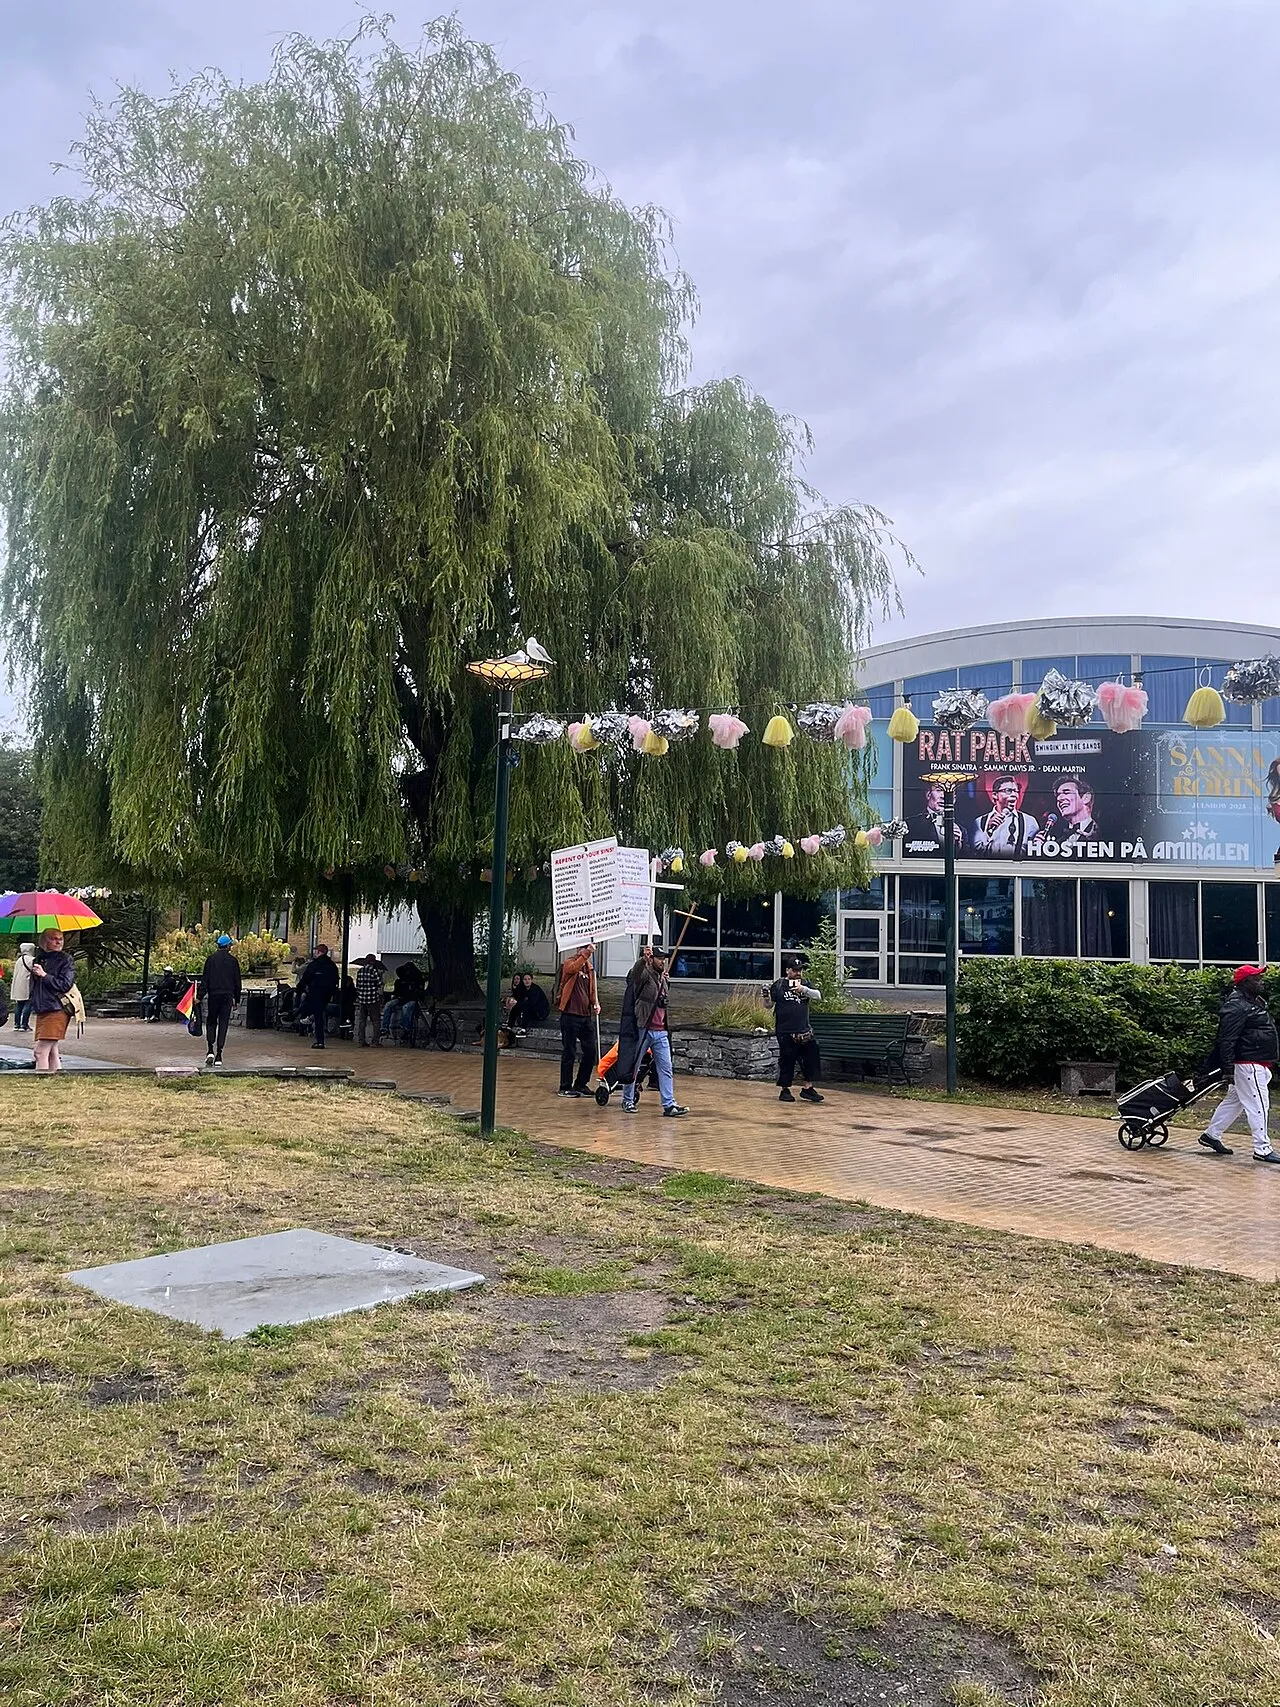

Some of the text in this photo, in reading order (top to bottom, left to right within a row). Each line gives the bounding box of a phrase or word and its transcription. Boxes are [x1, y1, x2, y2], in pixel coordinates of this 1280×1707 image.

[918, 730, 1032, 762] RAT PACK
[1082, 742, 1101, 750] SANDS
[1170, 745, 1264, 768] SANNA
[952, 763, 977, 771] SINATRA
[984, 764, 1008, 772] SAMMY
[1008, 764, 1027, 772] DAVIS
[1028, 764, 1036, 772] JR.
[1062, 765, 1086, 773] MARTIN
[1174, 776, 1262, 797] ROBIN
[555, 856, 576, 865] REPENT
[586, 850, 600, 858] YOUR
[1028, 837, 1250, 861] HÖSTEN PÅ AMIRALEN
